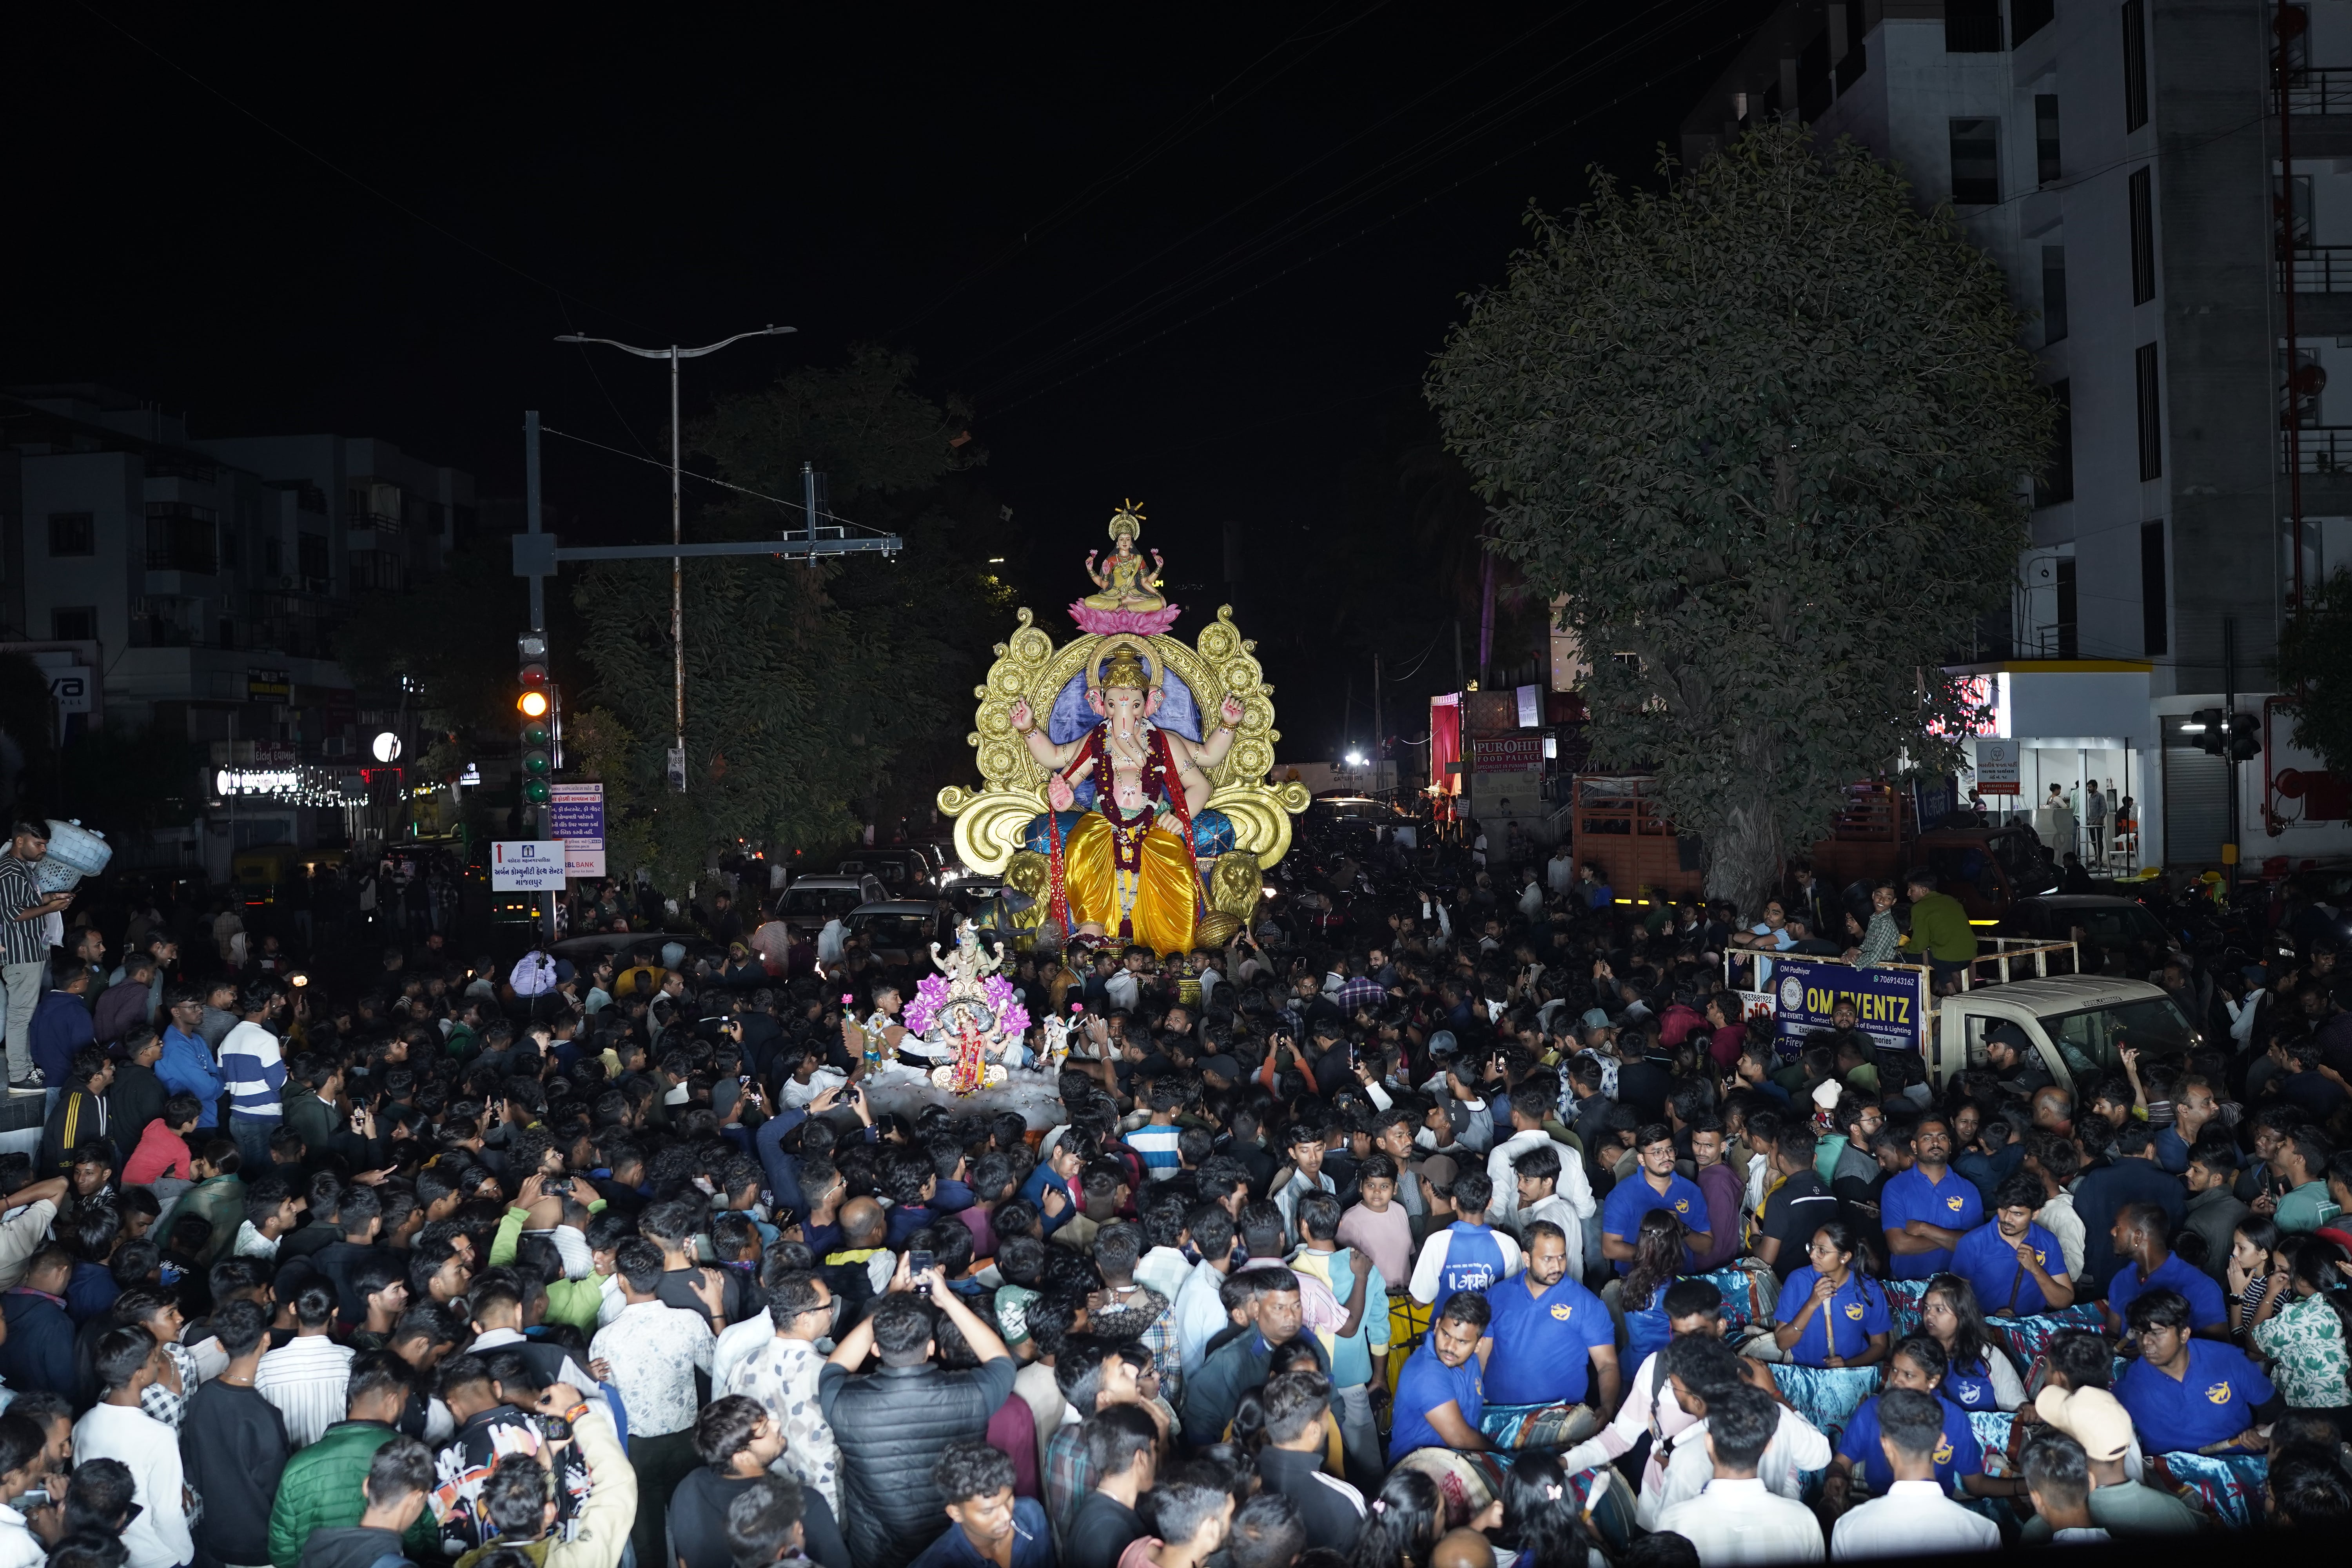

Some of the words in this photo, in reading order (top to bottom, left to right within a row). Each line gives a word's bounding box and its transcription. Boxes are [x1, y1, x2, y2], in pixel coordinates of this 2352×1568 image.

[1477, 740, 1541, 753] PUROHIT
[256, 748, 272, 765] દાંતનું
[274, 748, 296, 766] દવાખાનું
[494, 867, 509, 875] અર્બન
[536, 866, 547, 875] હેલ્થ
[549, 866, 563, 875] સેન્ટર
[515, 877, 543, 887] માંજલપુર
[1790, 966, 1811, 976] Padhiyar
[1880, 975, 1914, 986] 7069143162
[1787, 989, 1797, 998] OM
[2099, 996, 2121, 1004] CARRIAGE
[1807, 987, 1833, 1014] OM
[1840, 991, 1909, 1024] VENTZ
[1811, 1016, 1830, 1024] Contact
[1889, 1026, 1911, 1035] Lighting
[1871, 1036, 1892, 1045] emories
